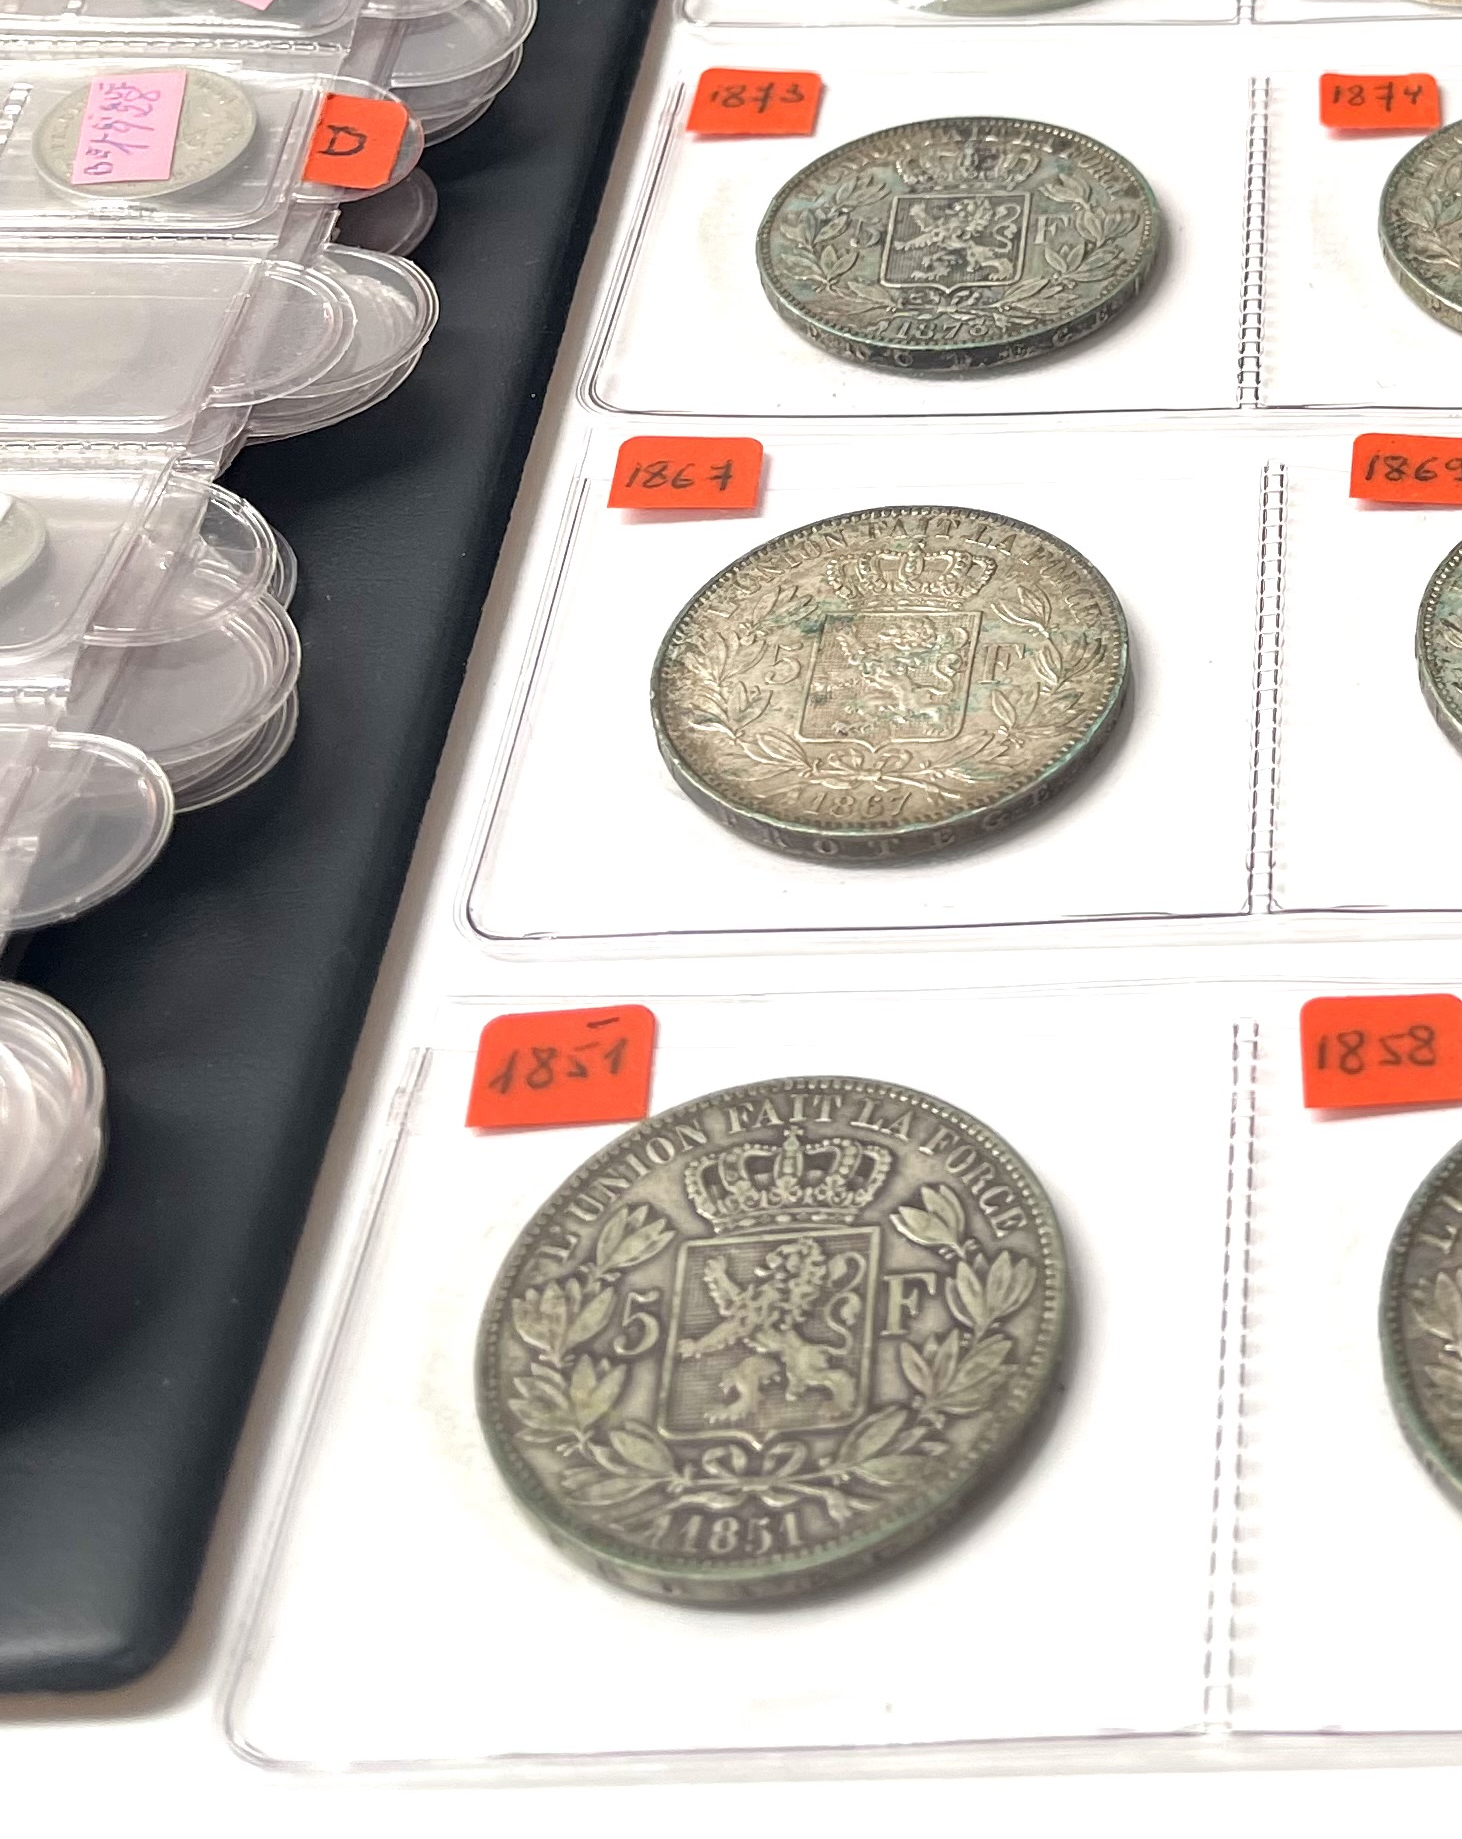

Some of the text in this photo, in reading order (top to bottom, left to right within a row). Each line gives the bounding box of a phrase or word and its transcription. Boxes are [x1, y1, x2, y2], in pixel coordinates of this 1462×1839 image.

[708, 80, 806, 113] 1873
[1330, 81, 1424, 113] 1874
[318, 124, 368, 157] D
[1033, 213, 1075, 245] F
[624, 460, 735, 492] 1867
[764, 641, 1026, 686] 5 F
[803, 791, 912, 819] 1867
[487, 1018, 629, 1095] 1851
[1315, 1023, 1439, 1077] 1858
[728, 1095, 843, 1135] FAIT
[849, 1098, 910, 1140] LA
[919, 1130, 1029, 1238] FORCE
[613, 1272, 938, 1359] 5 F
[679, 1511, 804, 1555] 1851
